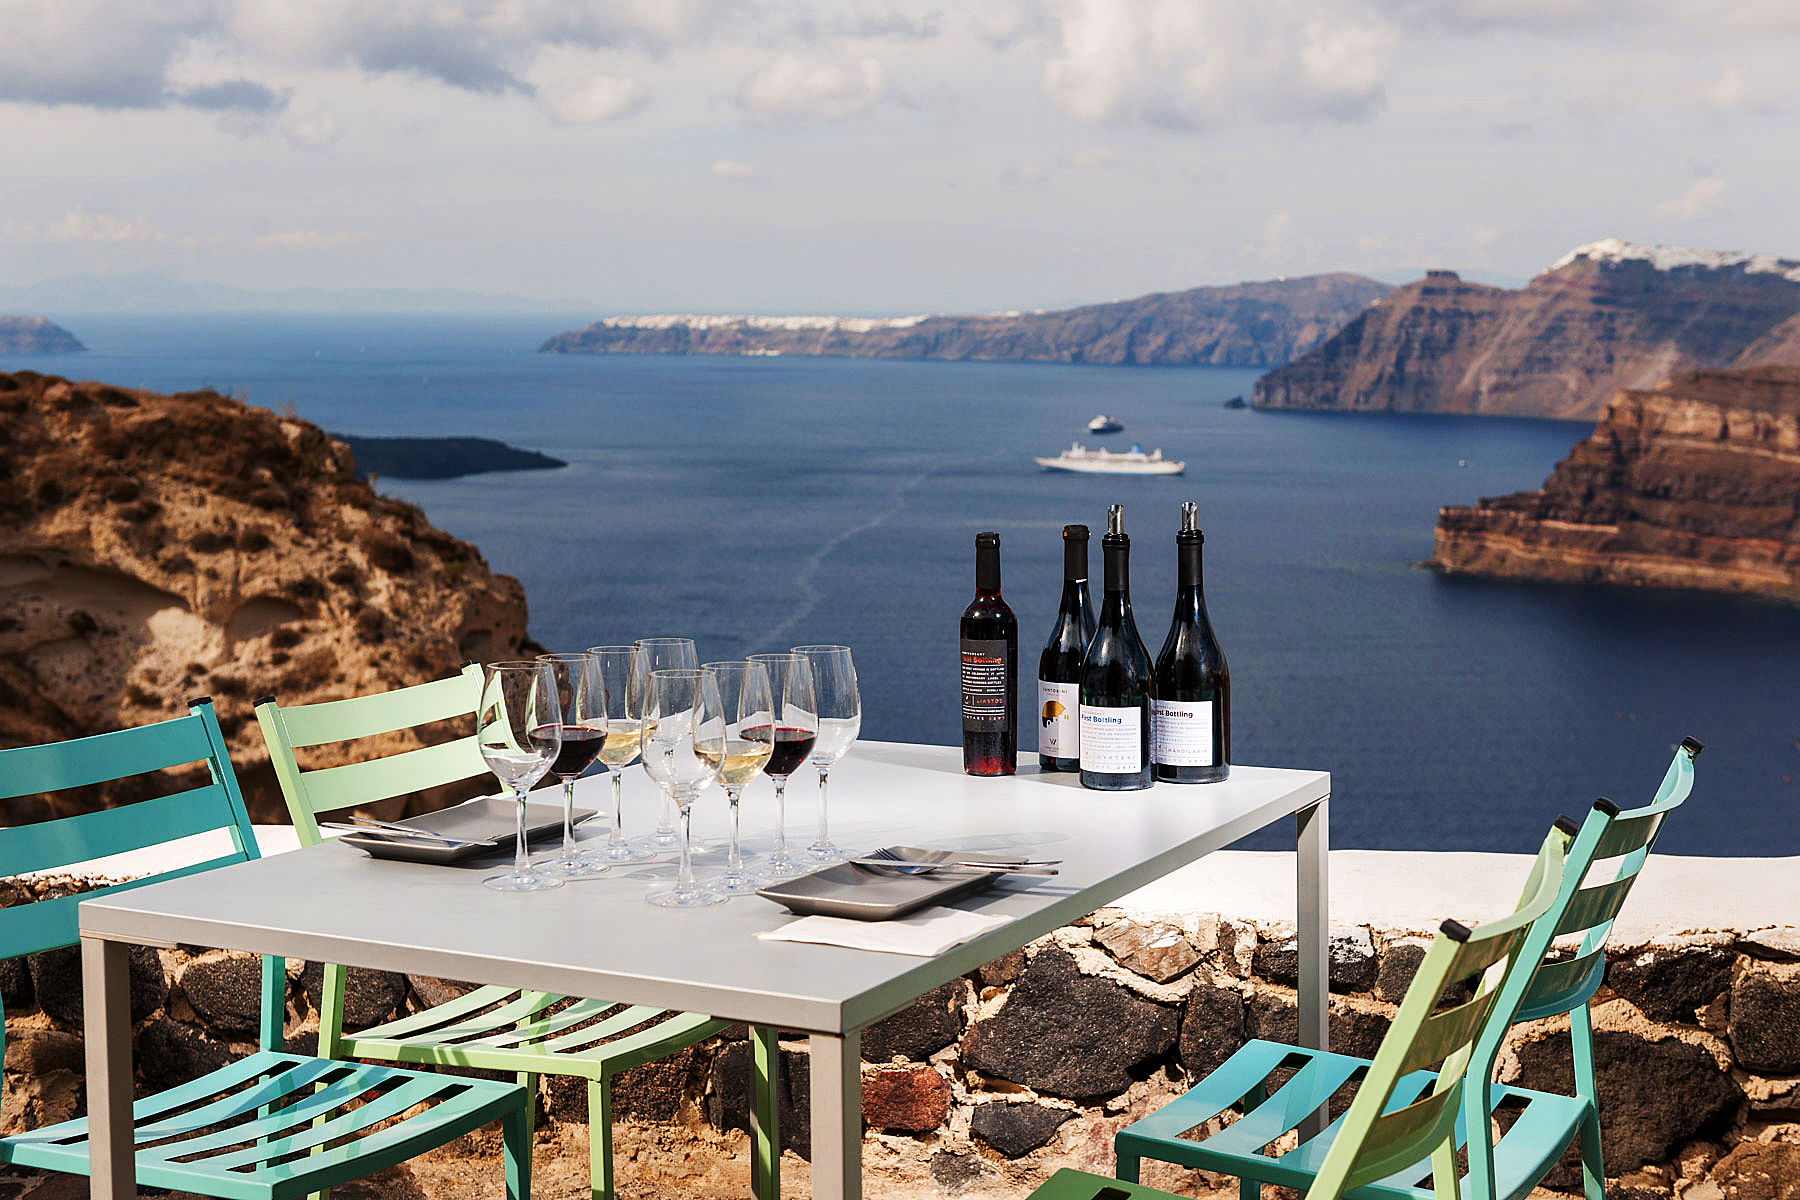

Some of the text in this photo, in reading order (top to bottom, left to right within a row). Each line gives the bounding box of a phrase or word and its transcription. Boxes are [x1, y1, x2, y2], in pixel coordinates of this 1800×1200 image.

[973, 656, 1002, 664] Bottling
[1165, 709, 1193, 718] Bottling
[1093, 715, 1122, 724] Bottling
